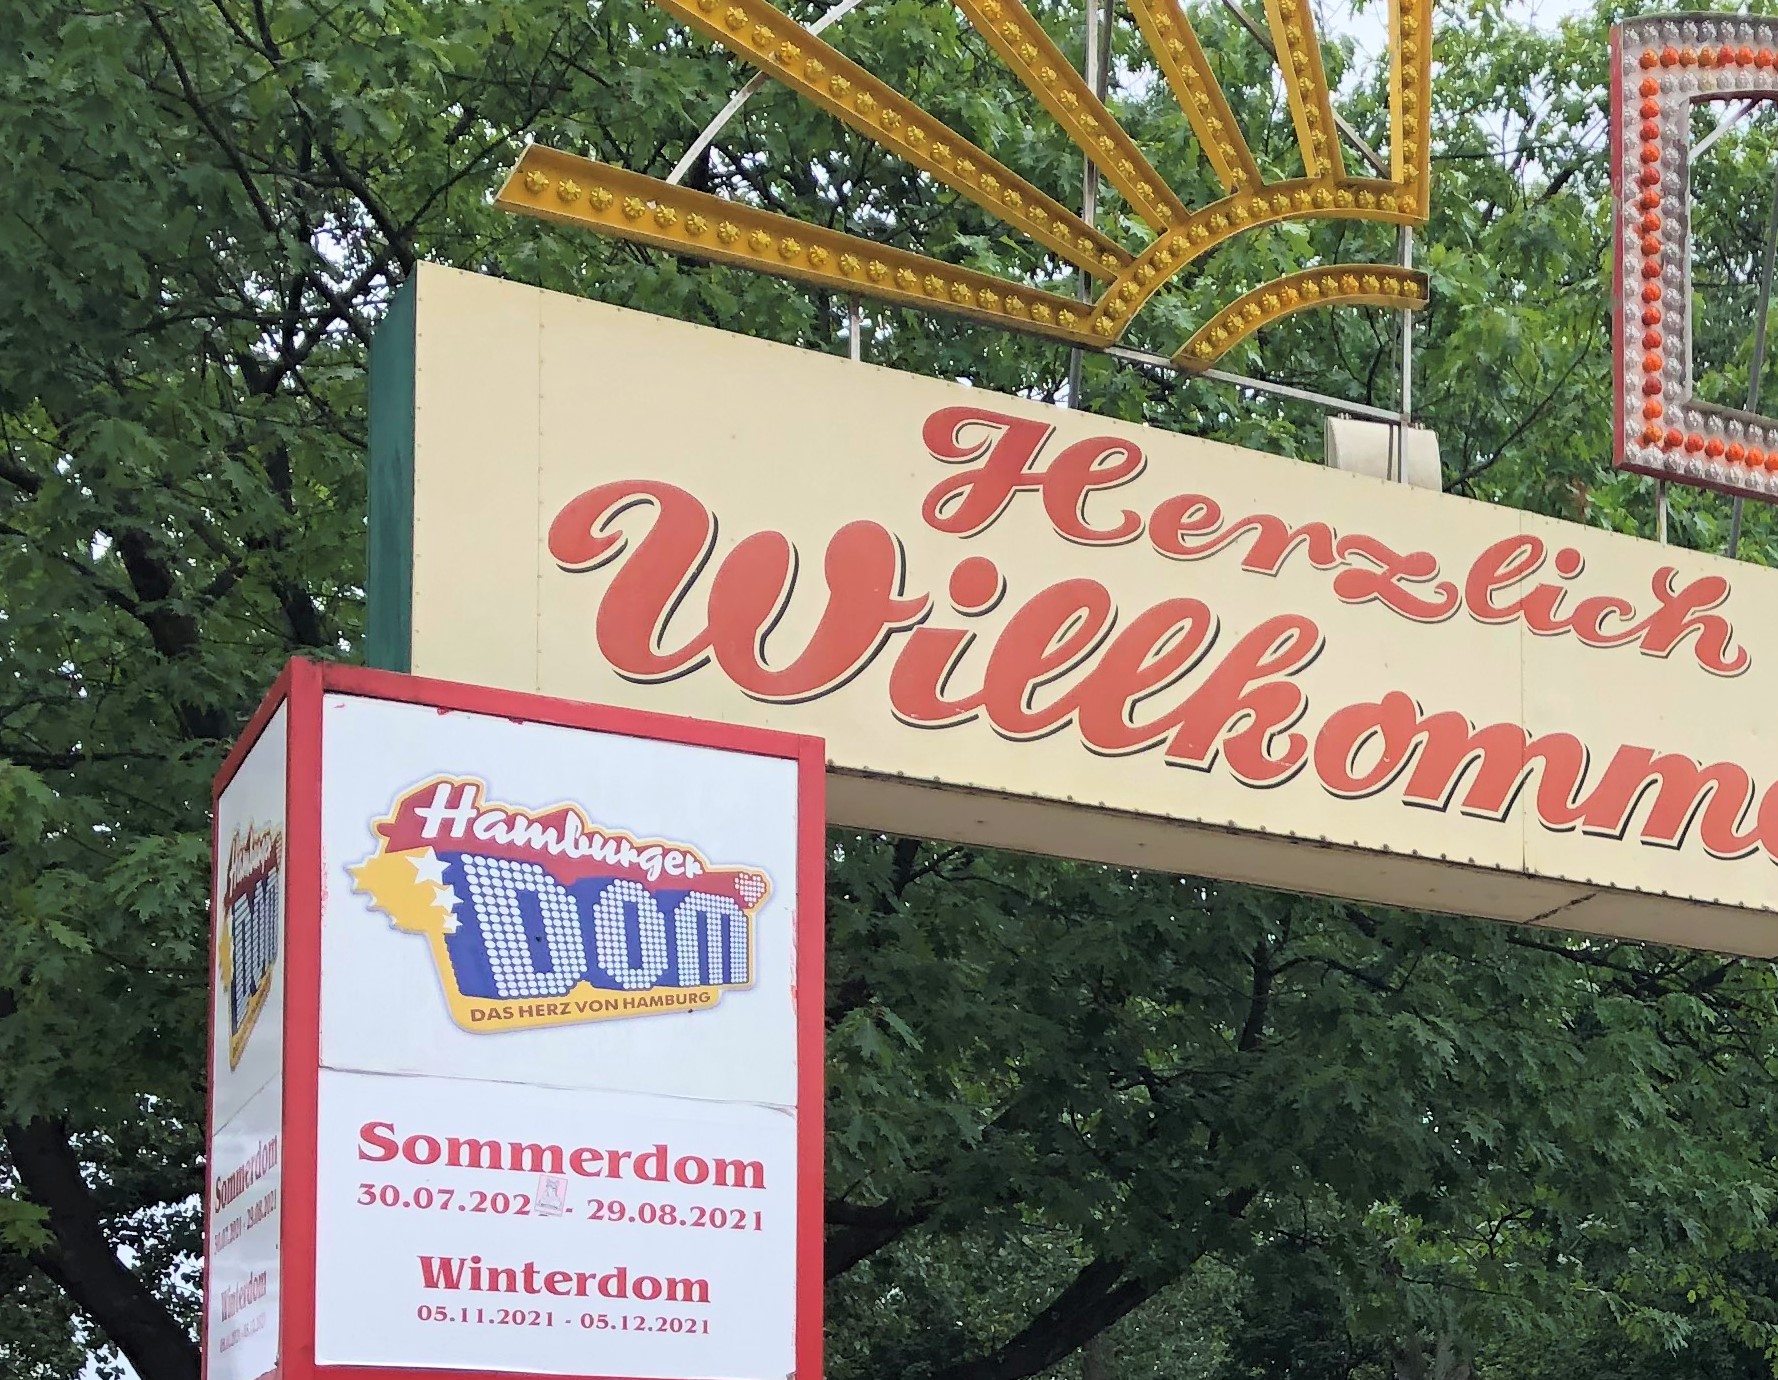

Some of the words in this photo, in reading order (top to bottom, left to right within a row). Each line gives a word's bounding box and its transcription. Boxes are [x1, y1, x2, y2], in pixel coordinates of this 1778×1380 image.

[921, 405, 1752, 677] Herzlich
[414, 785, 702, 881] Hamburger
[470, 1006, 514, 1022] DAS
[519, 1002, 571, 1018] HERZ
[575, 999, 619, 1012] VON
[623, 991, 711, 1009] HAMBURG
[215, 1135, 278, 1213] Sommerdom
[357, 1121, 767, 1189] Sommerdom
[357, 1183, 552, 1217] 30.07.202
[587, 1198, 763, 1232] 29.08.2021
[416, 1255, 711, 1303] Winterdom
[417, 1305, 554, 1326] 05.11.2021
[580, 1313, 710, 1335] 05.12.2021
